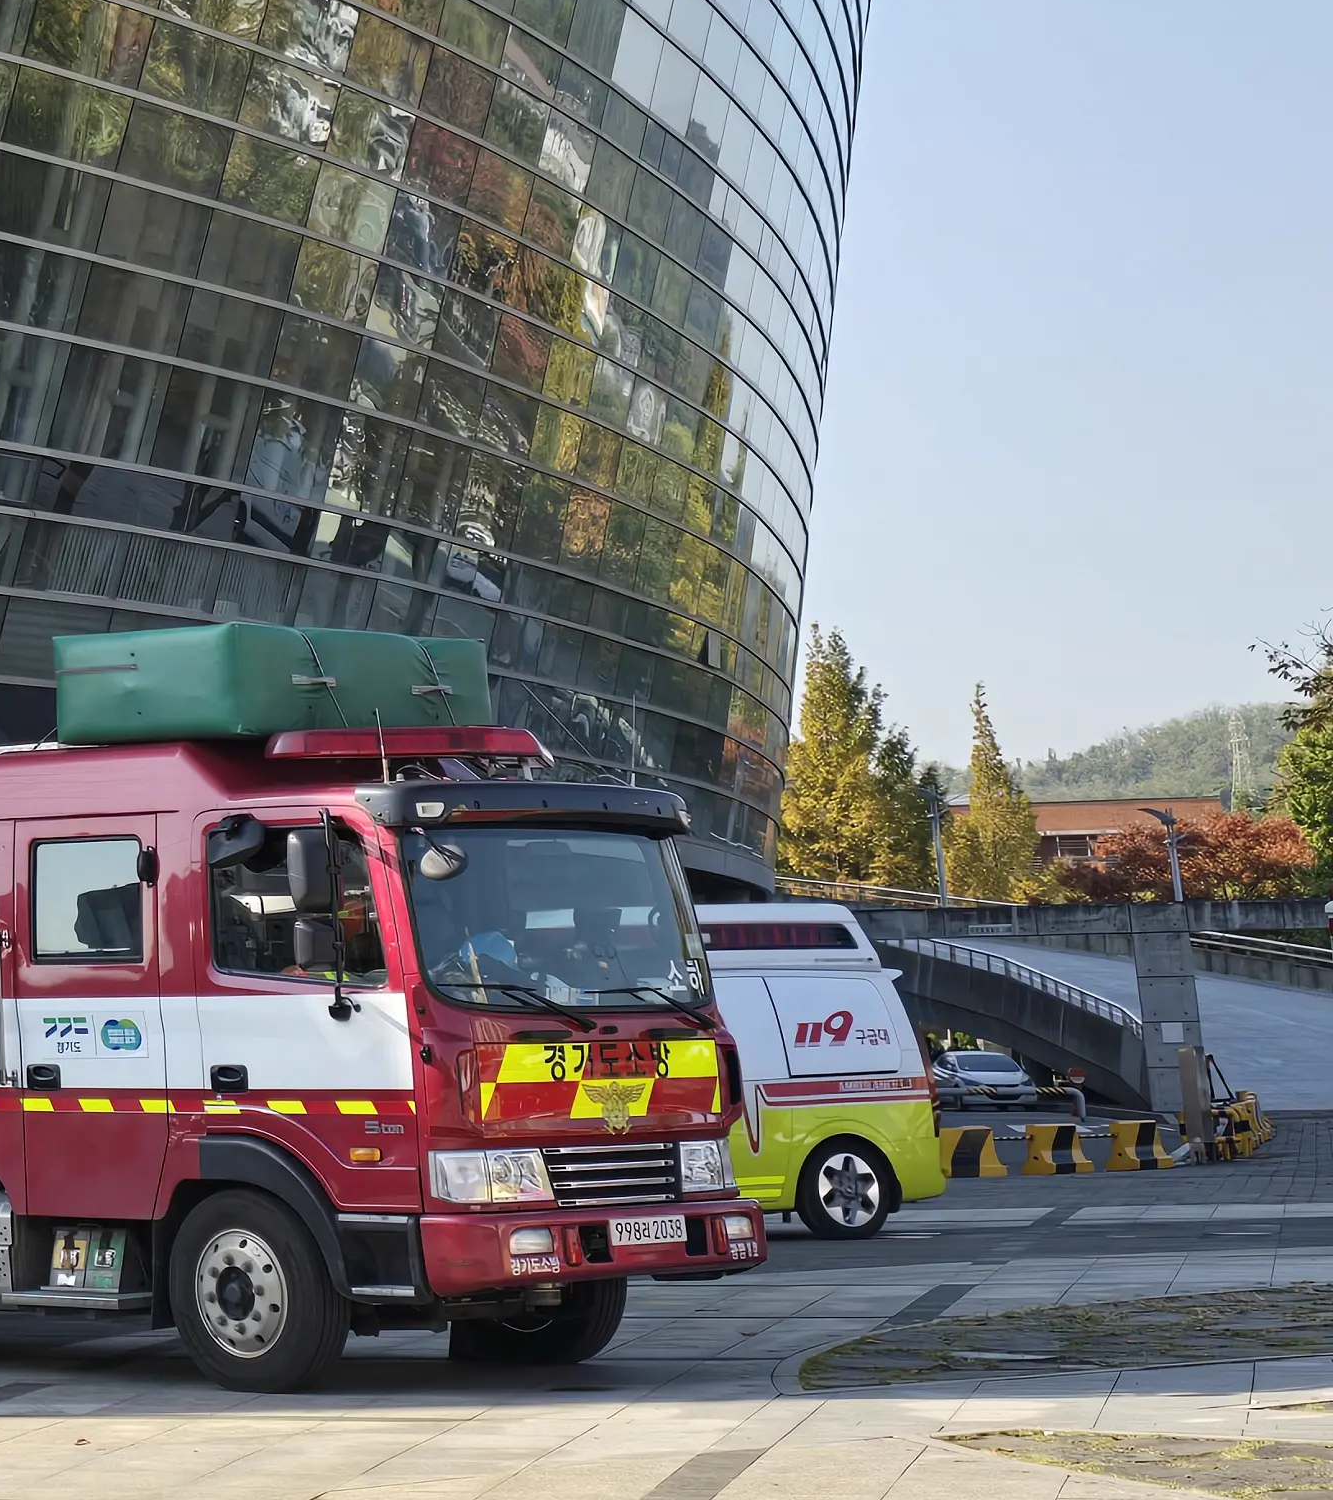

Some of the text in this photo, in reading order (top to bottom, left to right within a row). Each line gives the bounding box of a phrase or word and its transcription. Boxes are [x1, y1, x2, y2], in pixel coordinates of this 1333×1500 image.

[794, 1010, 854, 1048] 119
[855, 1028, 891, 1046] 구급대
[543, 1043, 671, 1081] 경기도소방
[652, 1219, 683, 1240] 2038
[510, 1256, 560, 1276] 경기도소방
